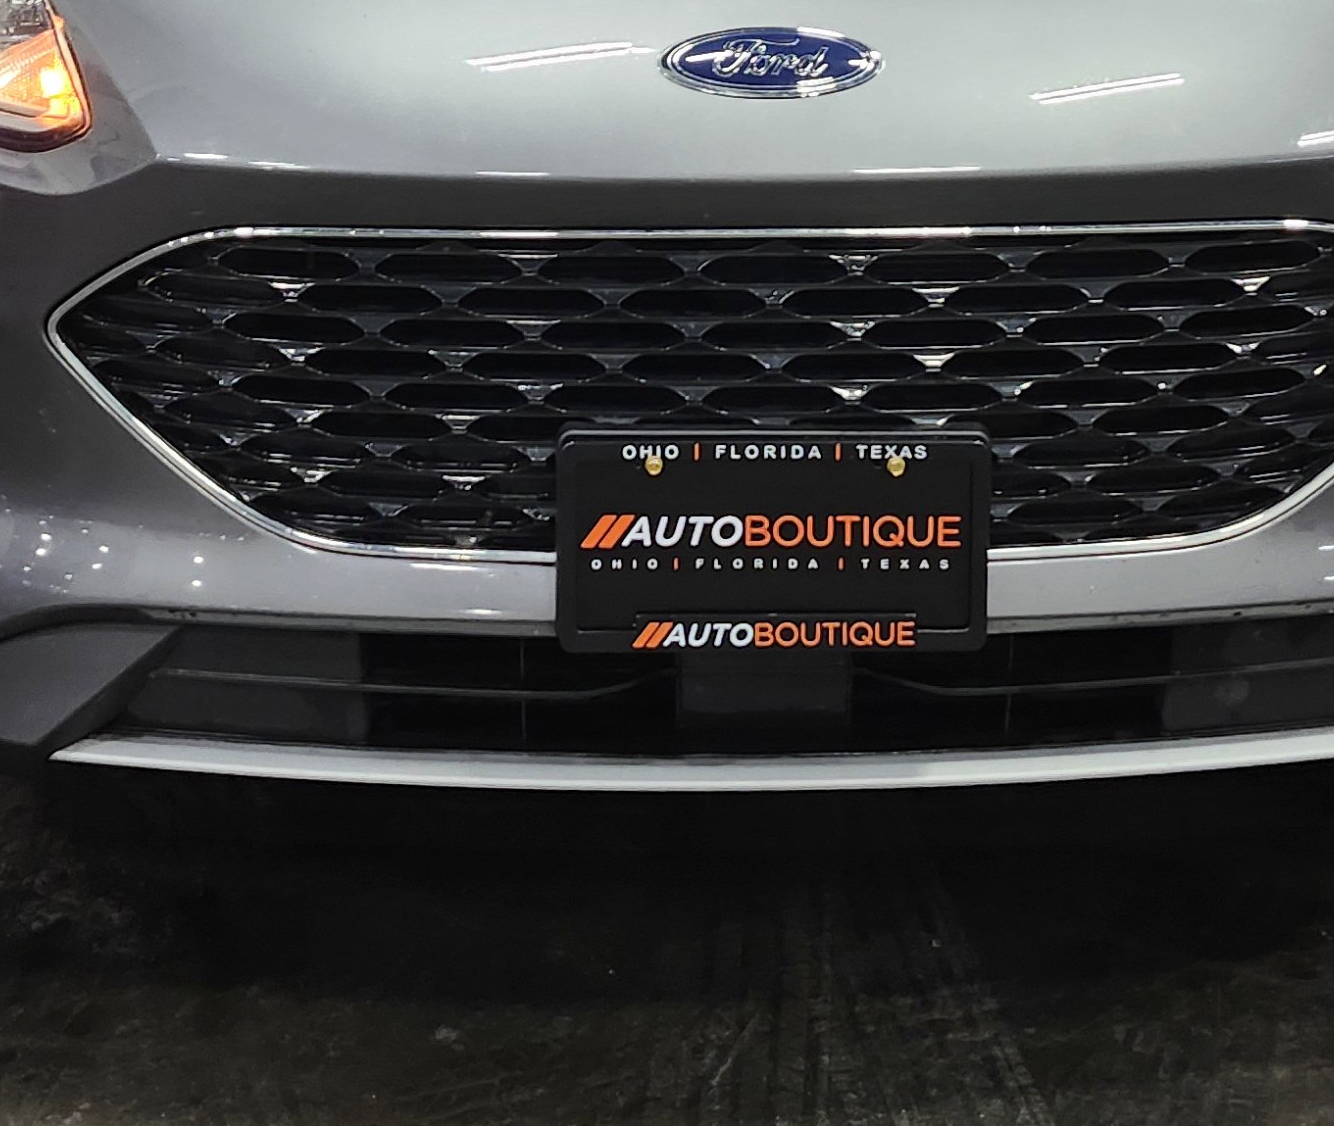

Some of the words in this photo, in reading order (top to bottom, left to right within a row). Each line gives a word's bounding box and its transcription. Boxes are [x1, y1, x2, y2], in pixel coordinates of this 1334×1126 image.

[711, 38, 829, 77] Ford
[622, 444, 679, 461] OHIO
[715, 444, 822, 460] FLORIDA
[855, 444, 928, 461] TEXAS
[621, 515, 961, 548] AUTOBOUTIQUE
[591, 558, 660, 571] OHIO
[695, 558, 819, 571] FLORIDA
[860, 558, 950, 571] TEXAS
[662, 621, 915, 648] AUTOBOUTIQUE
